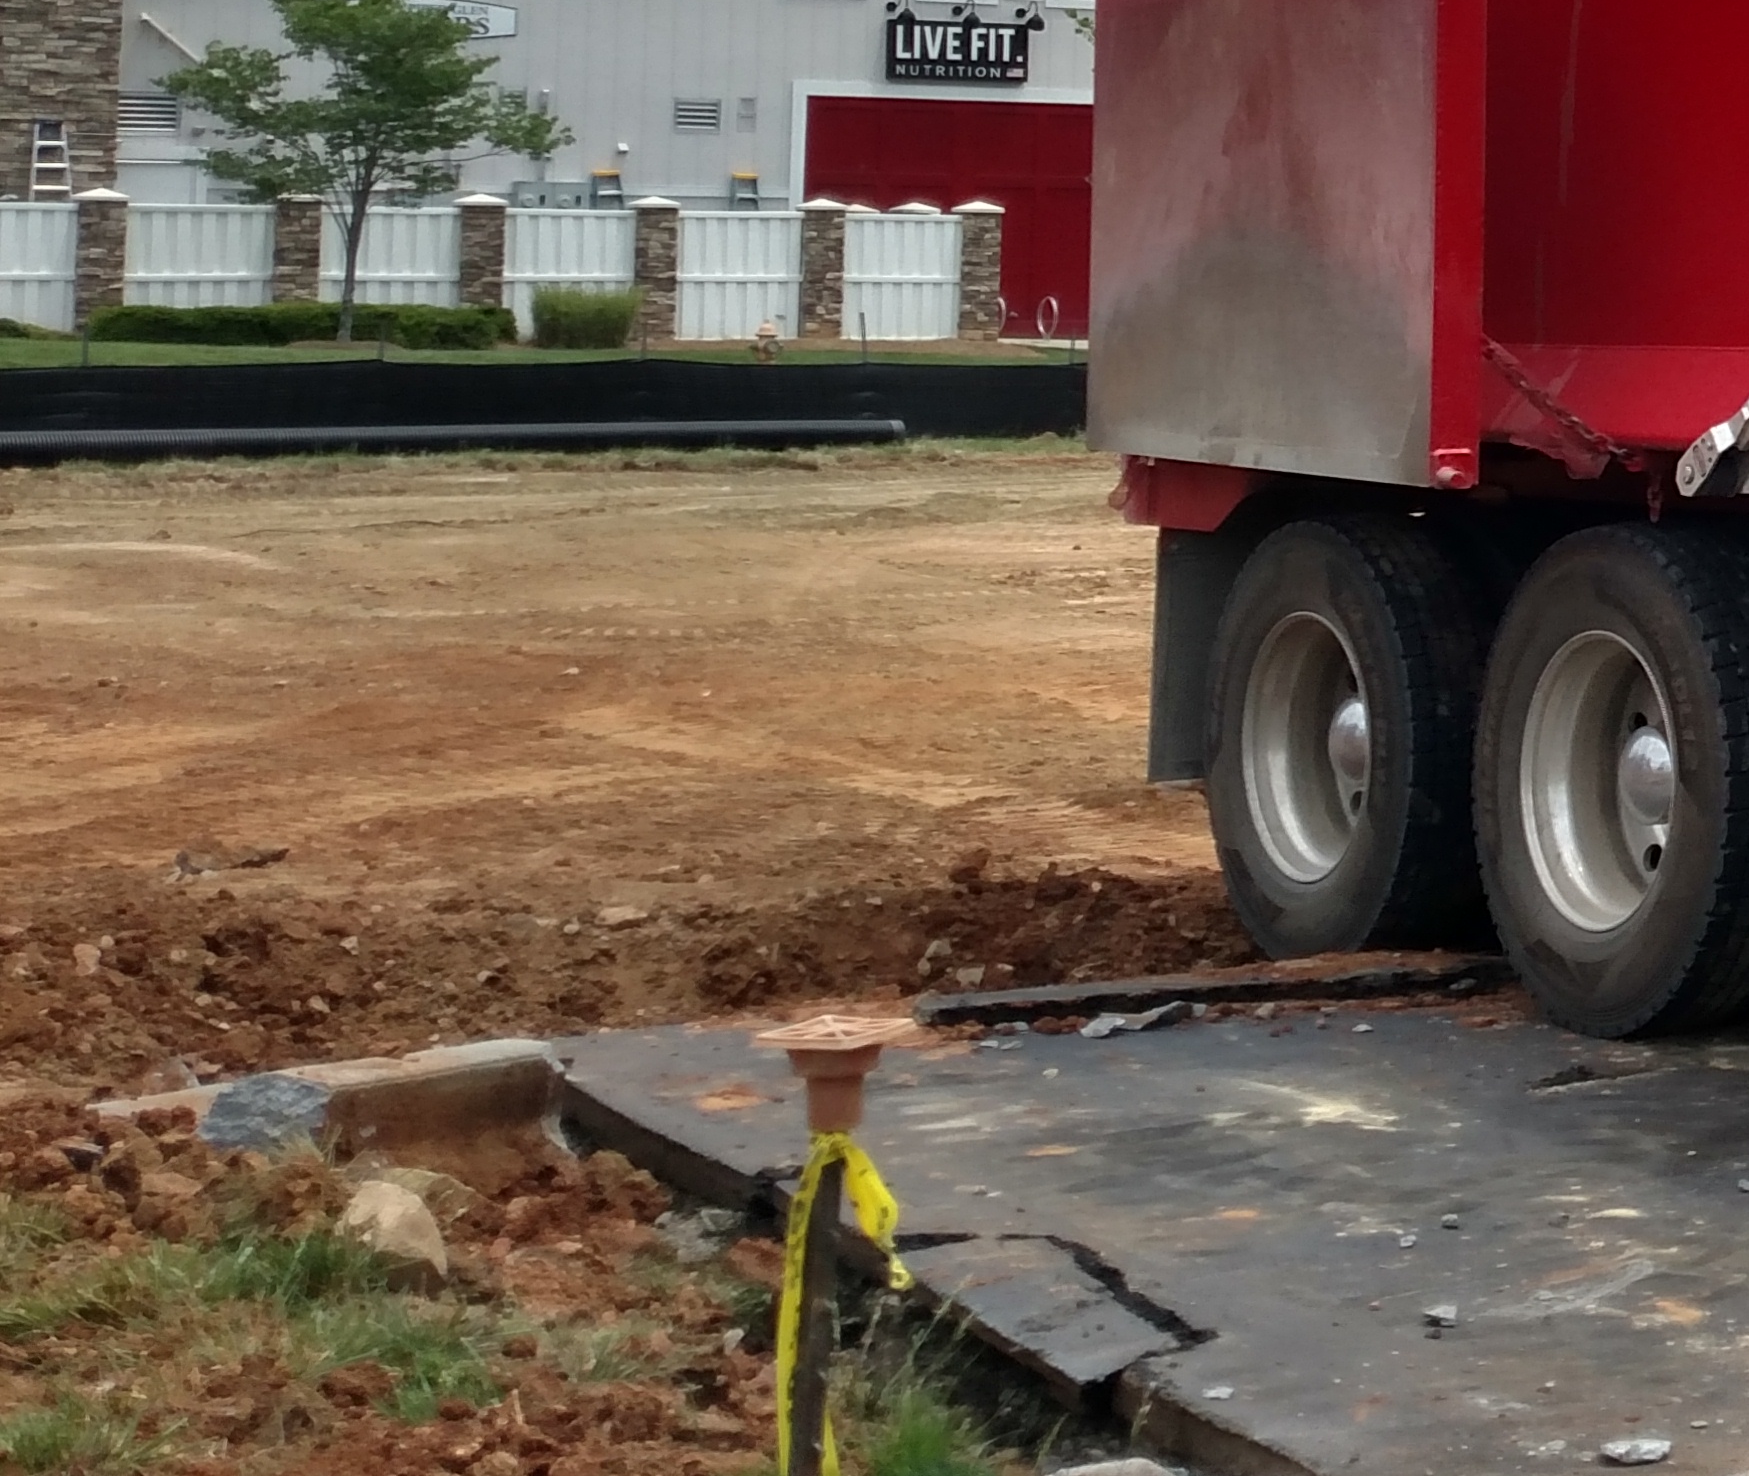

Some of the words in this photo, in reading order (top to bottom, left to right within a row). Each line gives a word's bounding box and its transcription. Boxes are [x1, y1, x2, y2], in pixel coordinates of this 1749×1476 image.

[895, 25, 963, 60] LIVE
[970, 28, 1023, 62] FIT.
[895, 64, 1001, 78] NUTRITION
